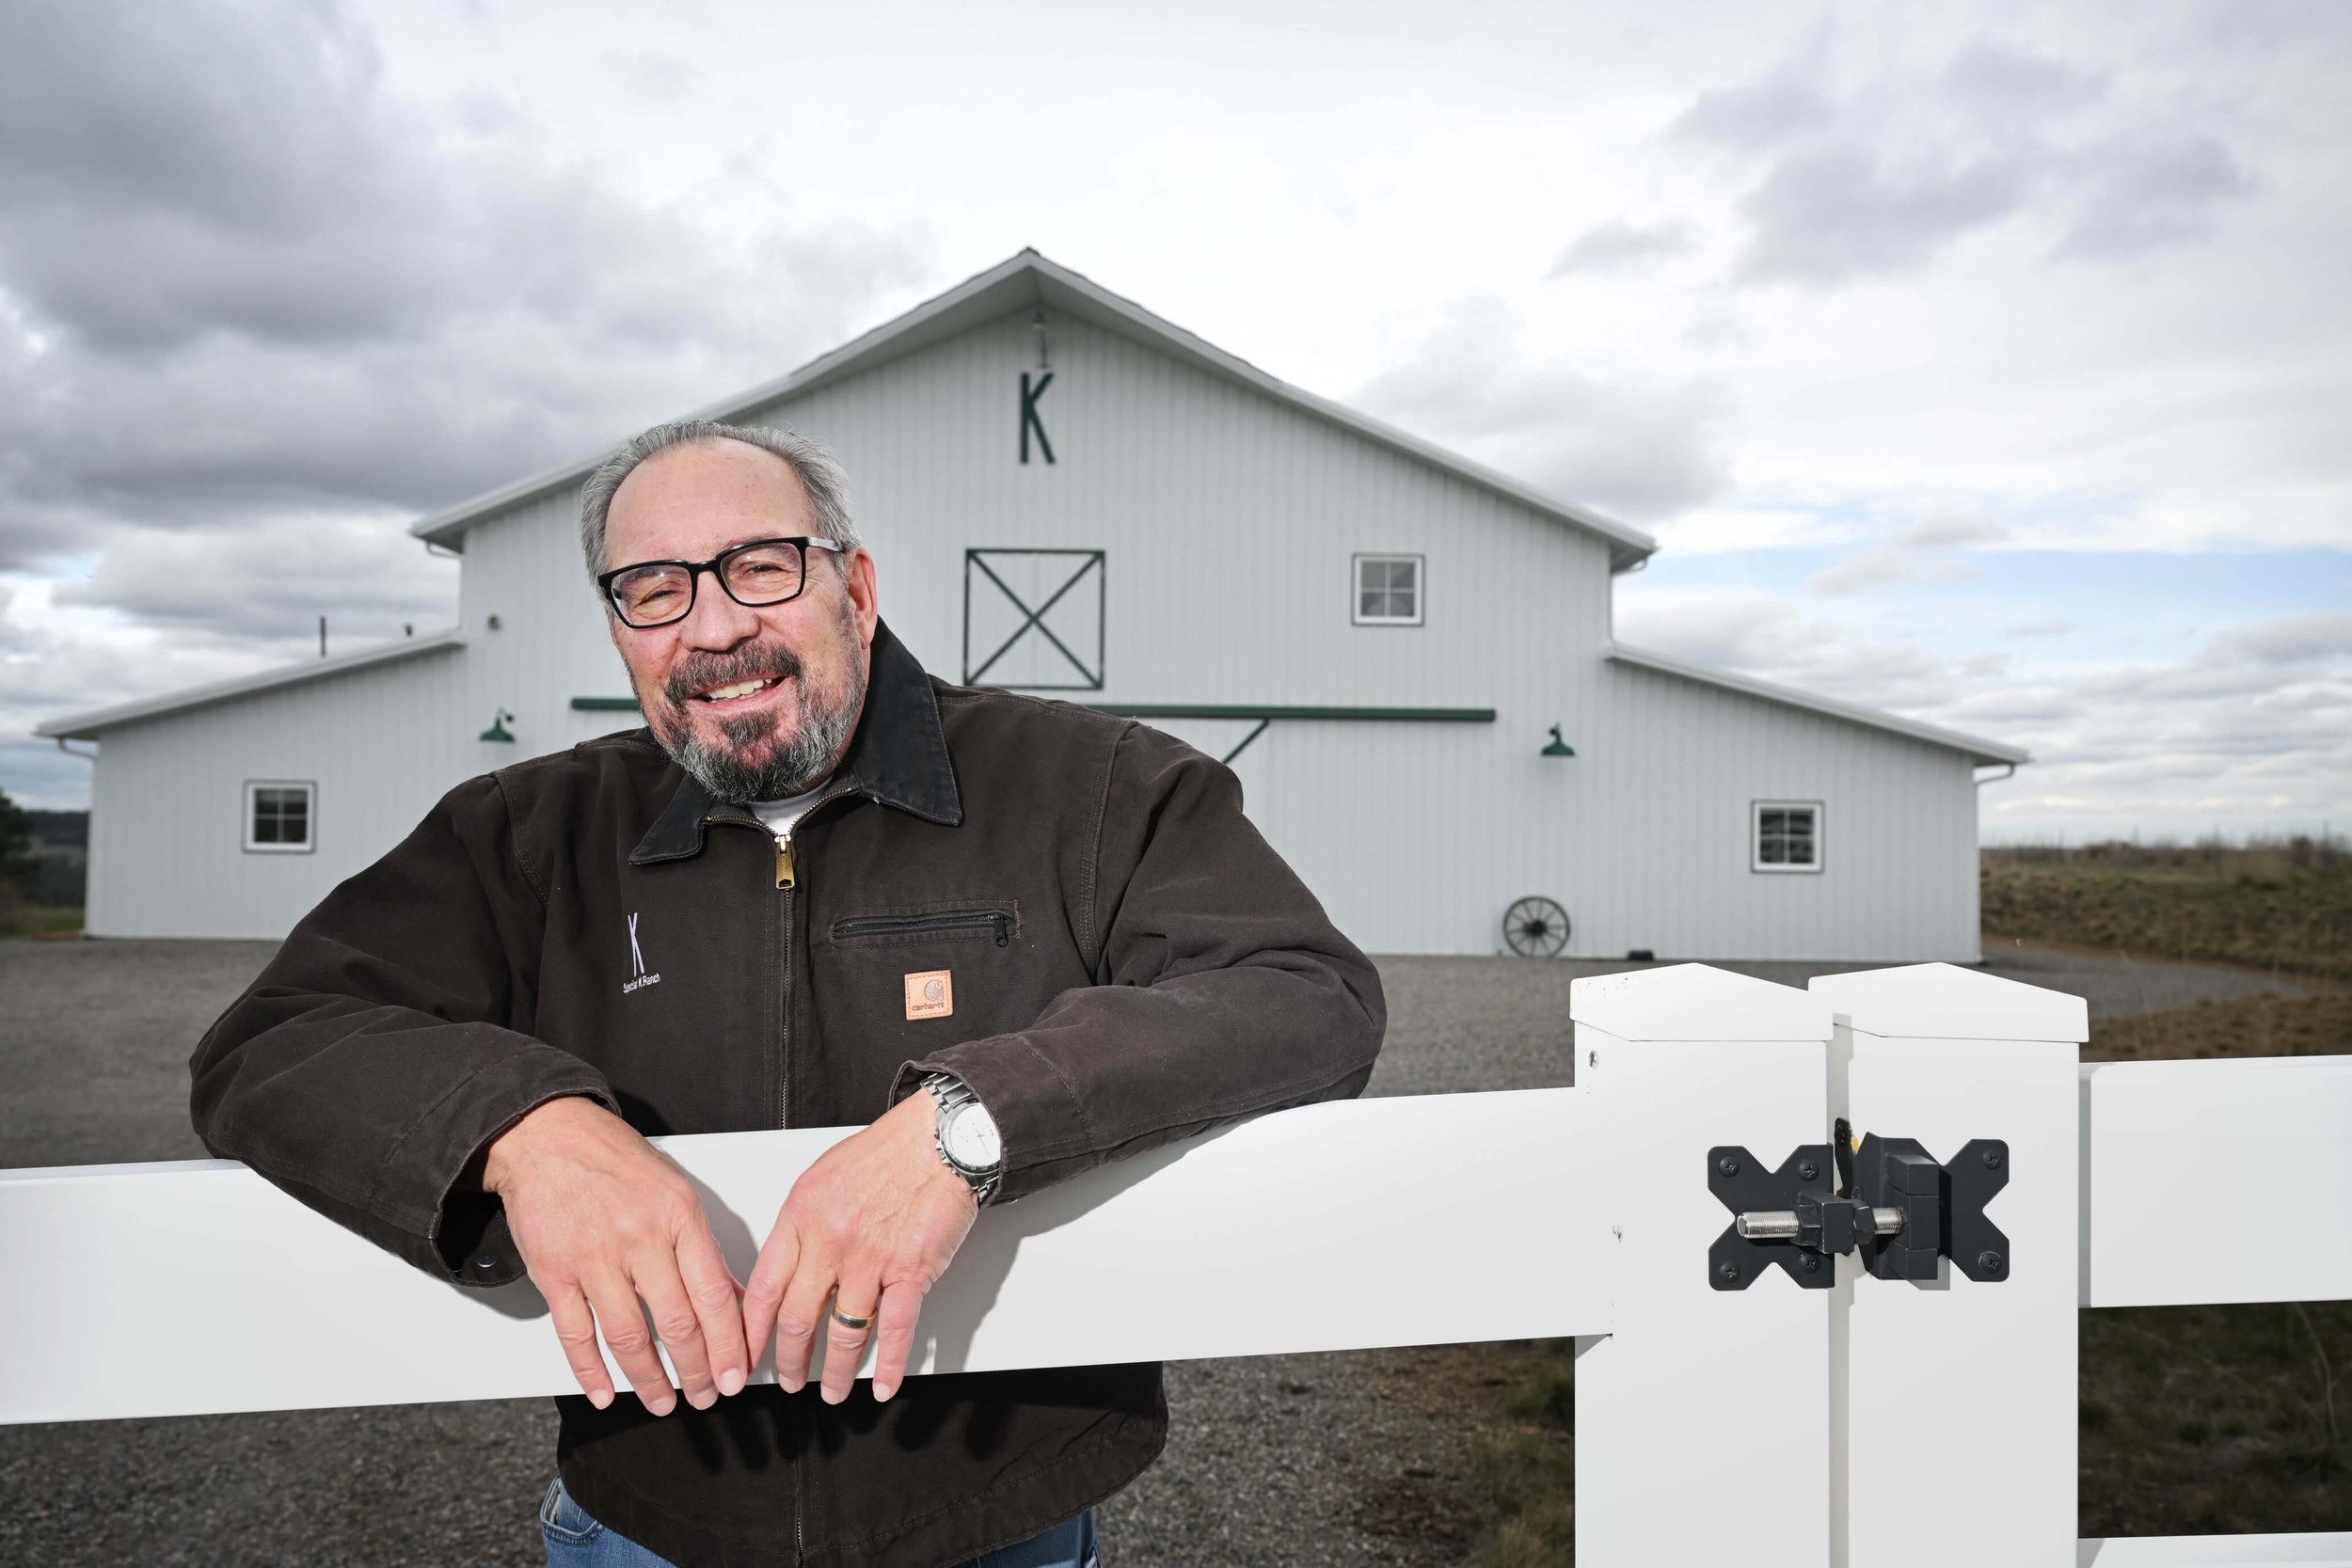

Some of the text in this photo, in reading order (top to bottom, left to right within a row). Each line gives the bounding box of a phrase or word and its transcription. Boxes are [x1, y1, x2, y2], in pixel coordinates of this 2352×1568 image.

[1020, 372, 1056, 465] K
[628, 912, 644, 977] K
[912, 1002, 945, 1011] carhartt
